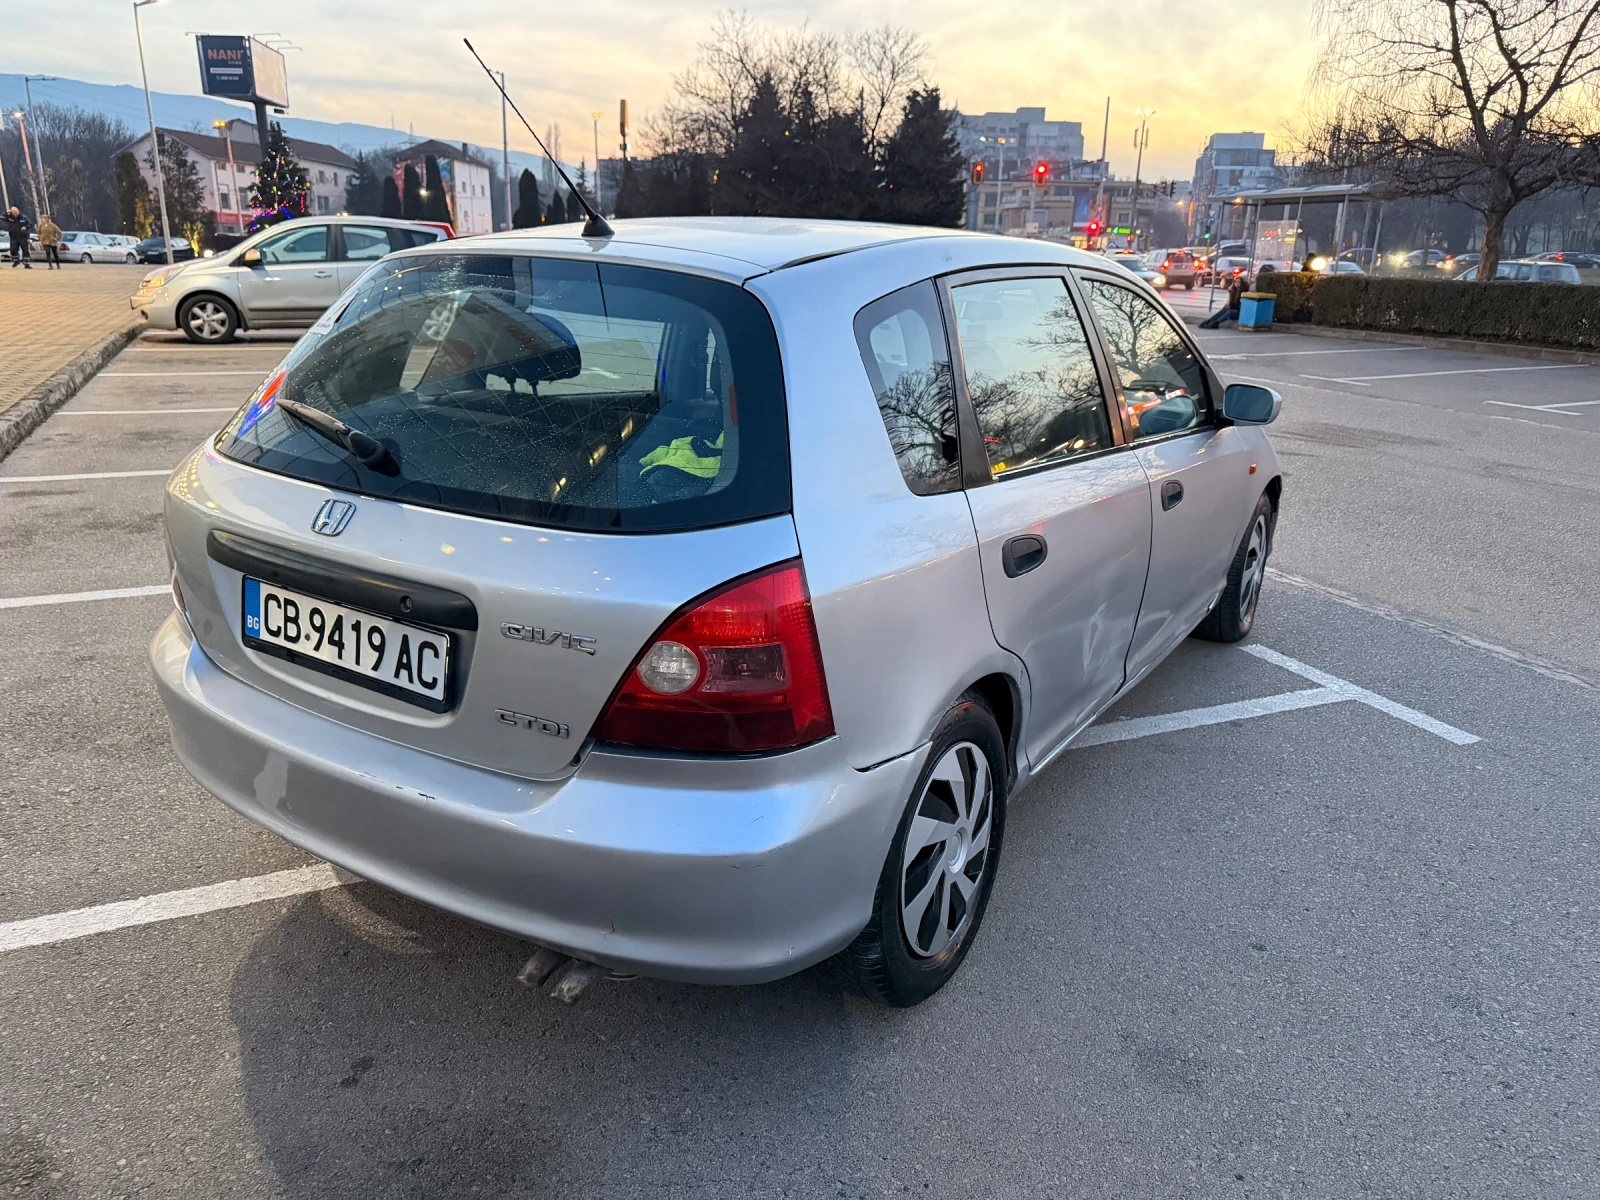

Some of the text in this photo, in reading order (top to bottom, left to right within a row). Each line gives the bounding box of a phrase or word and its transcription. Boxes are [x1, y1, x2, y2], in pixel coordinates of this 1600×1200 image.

[207, 48, 241, 60] NANI
[247, 615, 260, 630] BG
[264, 593, 440, 690] CB 9419 AC
[500, 622, 596, 656] CIVIC
[494, 708, 570, 739] CTDi
